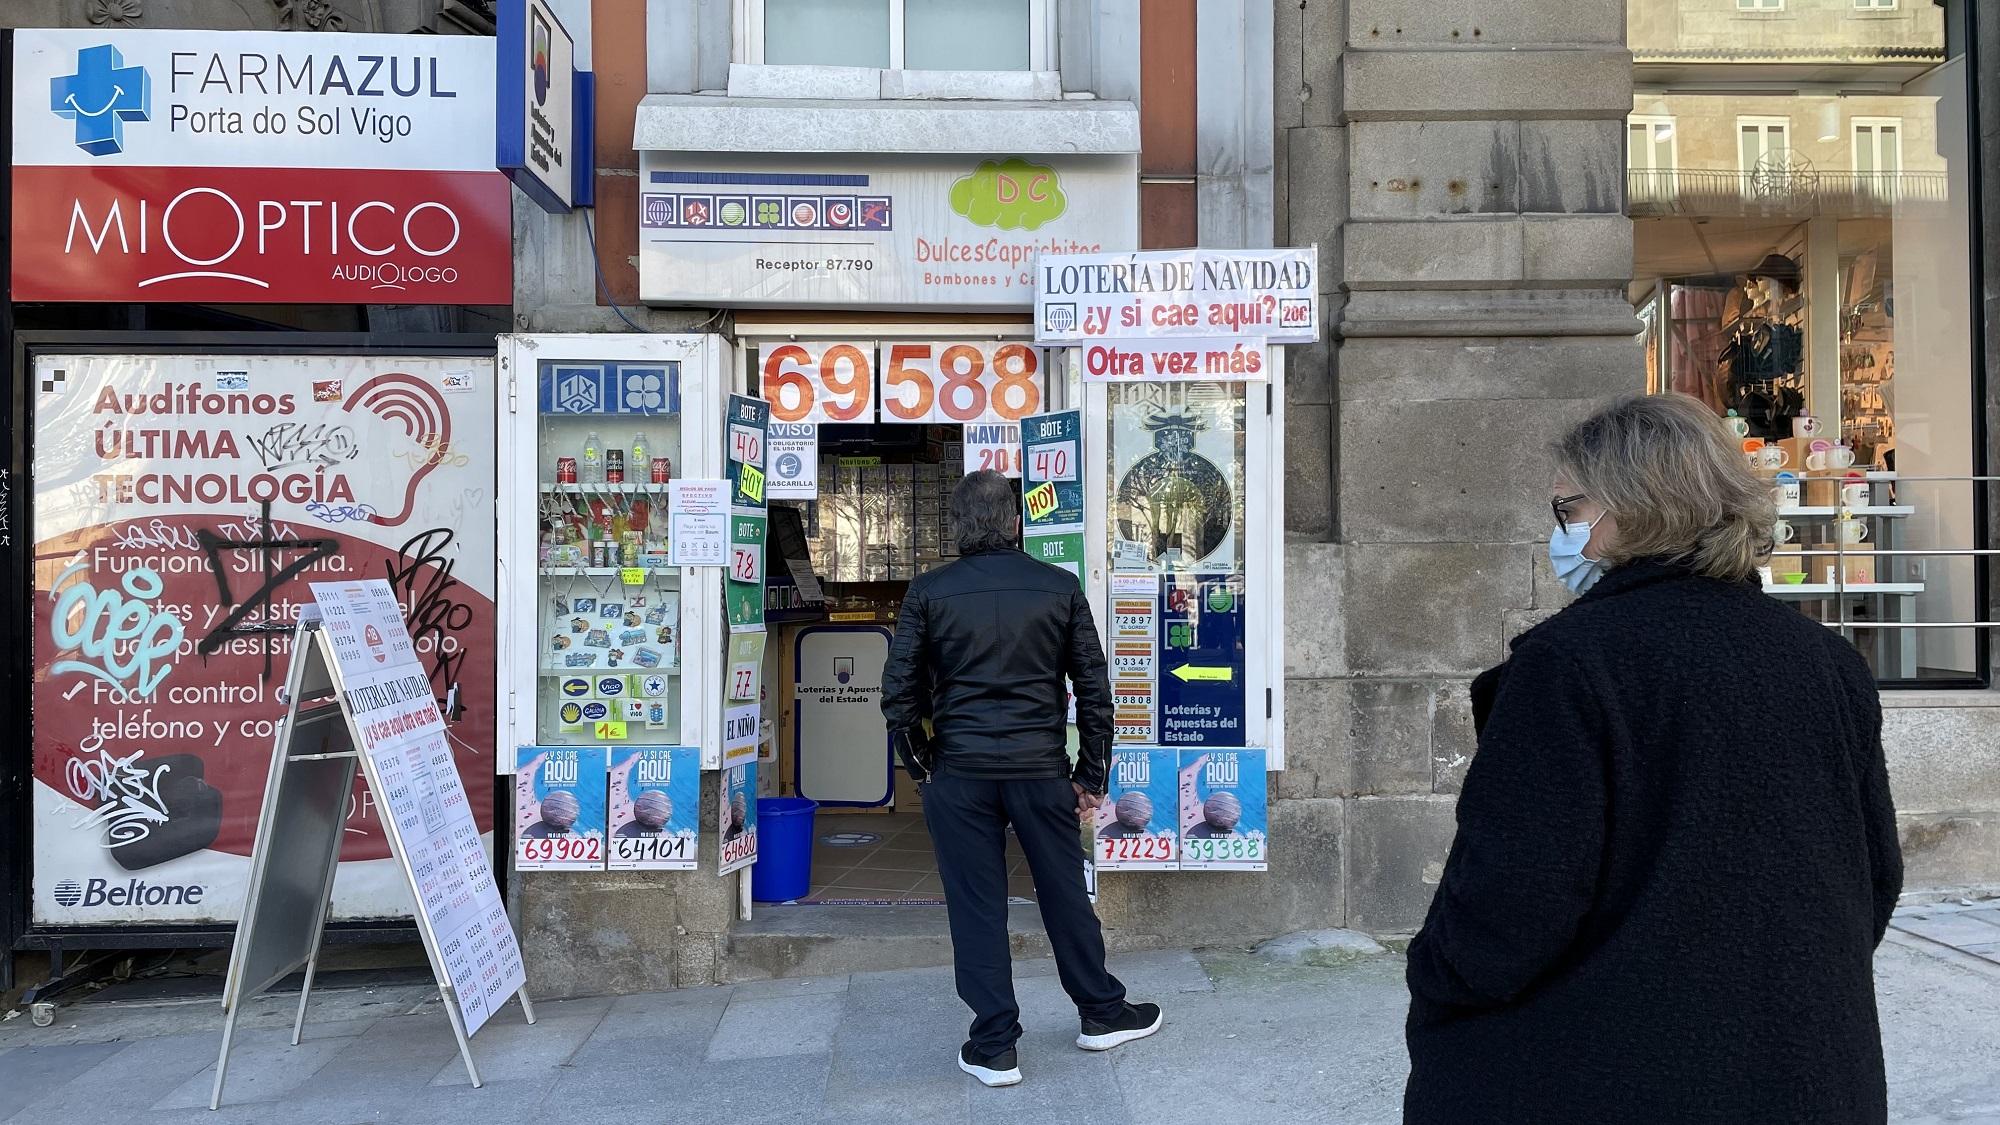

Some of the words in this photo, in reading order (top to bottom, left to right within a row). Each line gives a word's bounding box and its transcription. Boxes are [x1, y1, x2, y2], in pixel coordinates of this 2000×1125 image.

[169, 52, 457, 98] FARMAZUL
[169, 104, 244, 134] Porta
[252, 106, 286, 135] do
[297, 106, 341, 136] Sol
[351, 107, 412, 143] Vigo
[332, 262, 458, 284] AUDIOLOGO
[756, 258, 820, 272] Receptor
[826, 259, 873, 271] 87.790
[1044, 254, 1159, 295] LOTERÍA
[1161, 261, 1194, 291] DE
[1201, 260, 1311, 291] NAVIDAD
[924, 272, 997, 285] Bombones
[1005, 276, 1012, 288] y
[1083, 305, 1111, 334] ¿y
[1120, 299, 1142, 327] si
[1151, 303, 1199, 327] cae
[1207, 294, 1277, 333] aquí?
[1282, 305, 1308, 322] 20€
[1086, 345, 1145, 376] Otra
[1151, 352, 1198, 374] vez
[1205, 344, 1262, 374] más
[763, 344, 1041, 422] 69588
[94, 382, 296, 415] Audífonos
[740, 404, 756, 421] BOTE
[94, 420, 240, 459] ÚLTIMA
[768, 424, 814, 436] AVISO
[967, 425, 1021, 444] NAVID
[1040, 421, 1063, 438] BOTE
[94, 465, 356, 504] TECNOLOGÍA
[742, 467, 762, 498] HOY
[1028, 483, 1055, 516] HOY
[738, 523, 754, 537] BOTE
[1043, 541, 1065, 557] BOTE
[232, 549, 283, 573] SIN
[202, 603, 220, 630] y
[1115, 616, 1152, 624] 72897
[1115, 658, 1152, 666] 03347
[168, 673, 263, 703] control
[348, 677, 390, 714] LOTERÍA
[384, 681, 402, 704] DE
[395, 674, 430, 701] NAVIDAD
[798, 685, 836, 693] Loterías
[847, 686, 882, 694] Apuest
[1115, 696, 1151, 704] 58808
[1164, 704, 1212, 715] Loterías
[1214, 706, 1221, 716] y
[92, 709, 204, 740] teléfono
[214, 719, 232, 746] y
[727, 719, 736, 741] EL
[737, 713, 756, 738] NIÑO
[1114, 727, 1151, 735] 22253
[1165, 718, 1218, 730] Apuestas
[1219, 717, 1238, 728] del
[1164, 731, 1204, 742] Estado
[565, 751, 579, 761] CAE
[659, 751, 672, 761] CAE
[1137, 752, 1150, 762] CAE
[1225, 752, 1238, 762] CAE
[525, 837, 601, 860] 69902
[618, 837, 685, 860] 64101
[724, 836, 756, 862] 64680
[1104, 837, 1171, 860] 72229
[1189, 838, 1259, 860] 59388
[83, 878, 204, 906] Beltone
